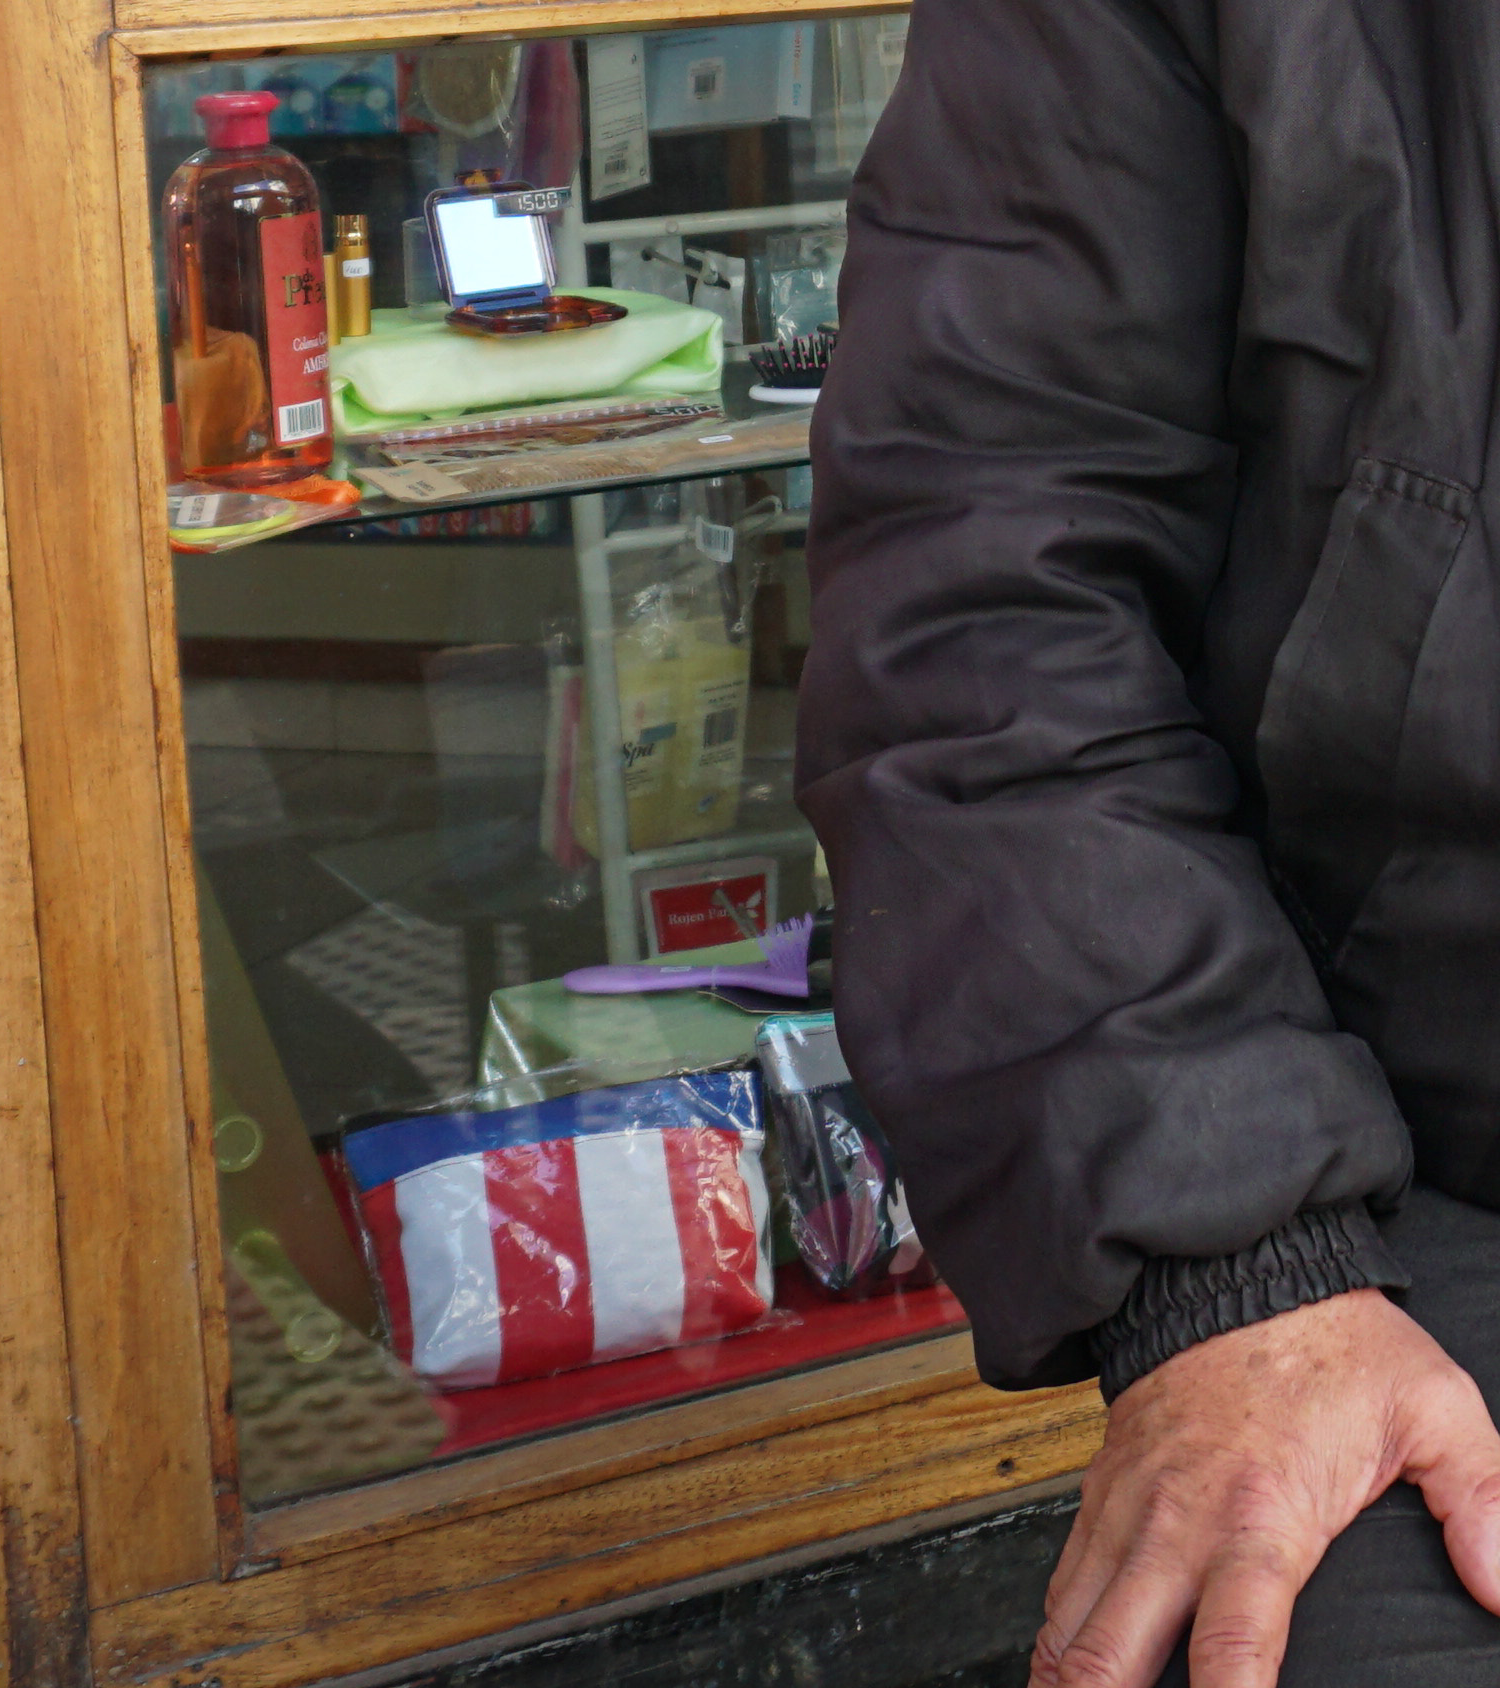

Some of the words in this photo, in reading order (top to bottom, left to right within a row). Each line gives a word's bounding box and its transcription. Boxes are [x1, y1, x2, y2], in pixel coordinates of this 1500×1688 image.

[518, 191, 559, 211] 1.500
[622, 742, 655, 768] Spa
[668, 912, 705, 925] Rojen
